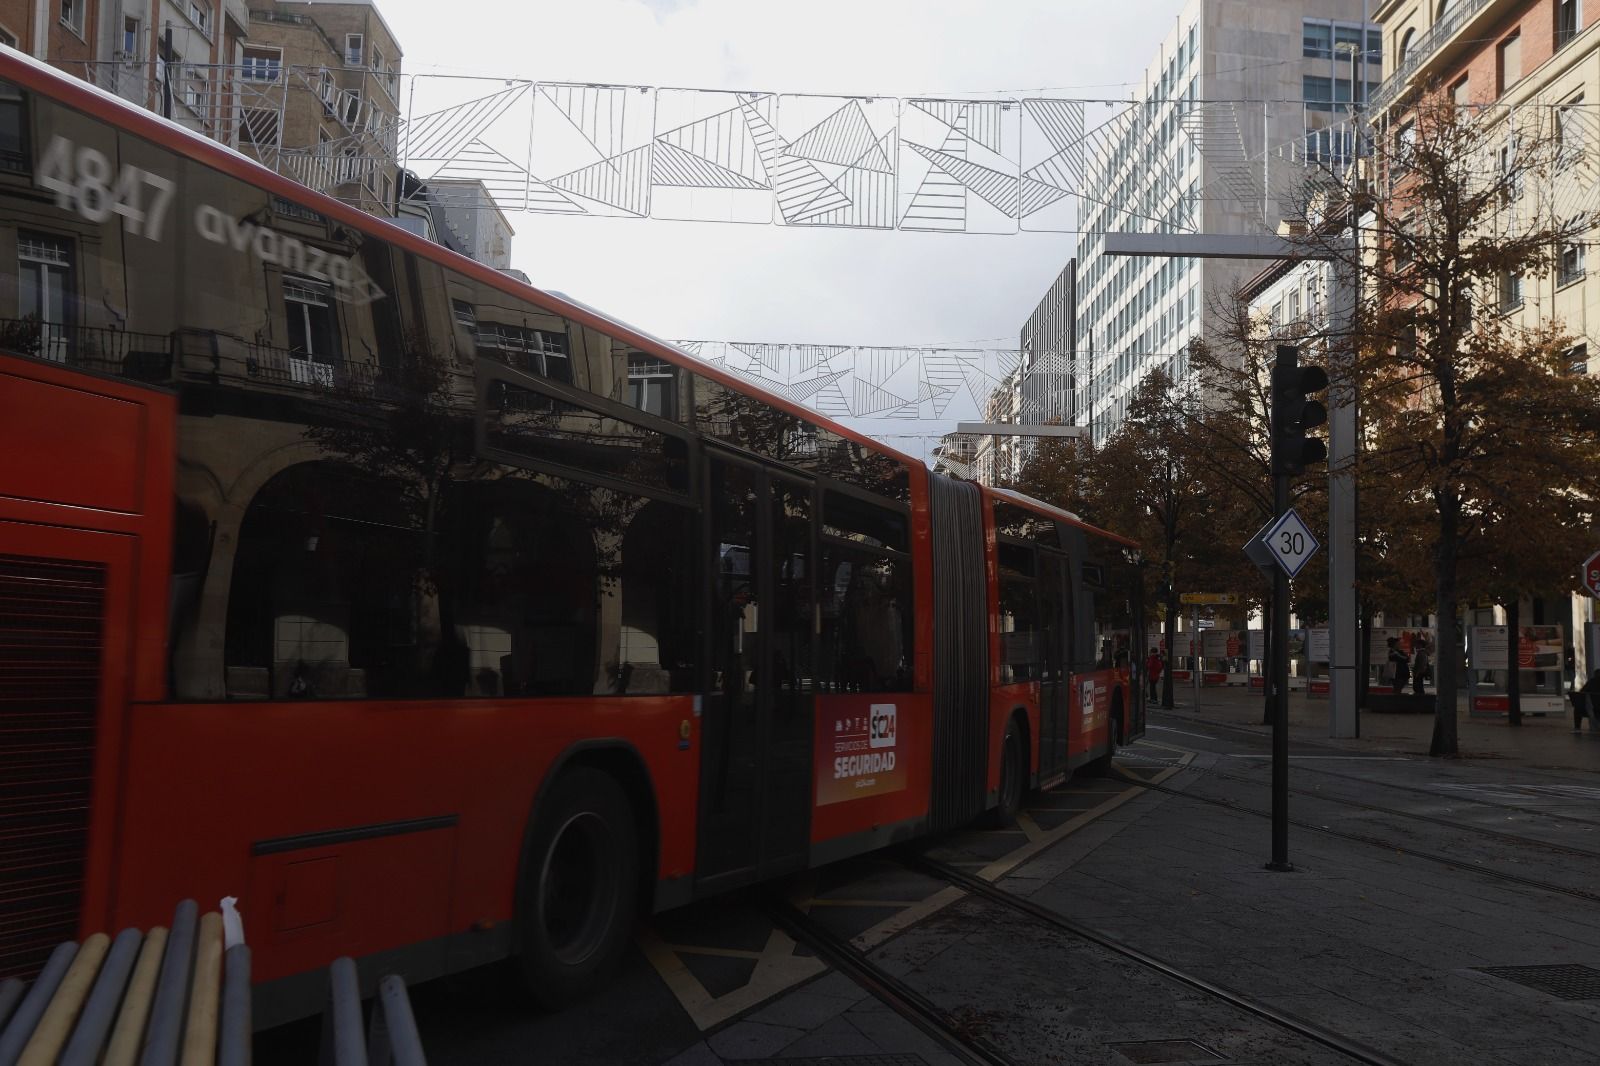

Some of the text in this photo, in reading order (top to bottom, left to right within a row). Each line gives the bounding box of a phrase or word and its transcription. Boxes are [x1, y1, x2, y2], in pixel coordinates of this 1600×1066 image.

[38, 134, 177, 242] 4847
[194, 203, 356, 290] avanza
[1280, 532, 1305, 555] 30
[833, 751, 896, 779] SEGURIDAD
